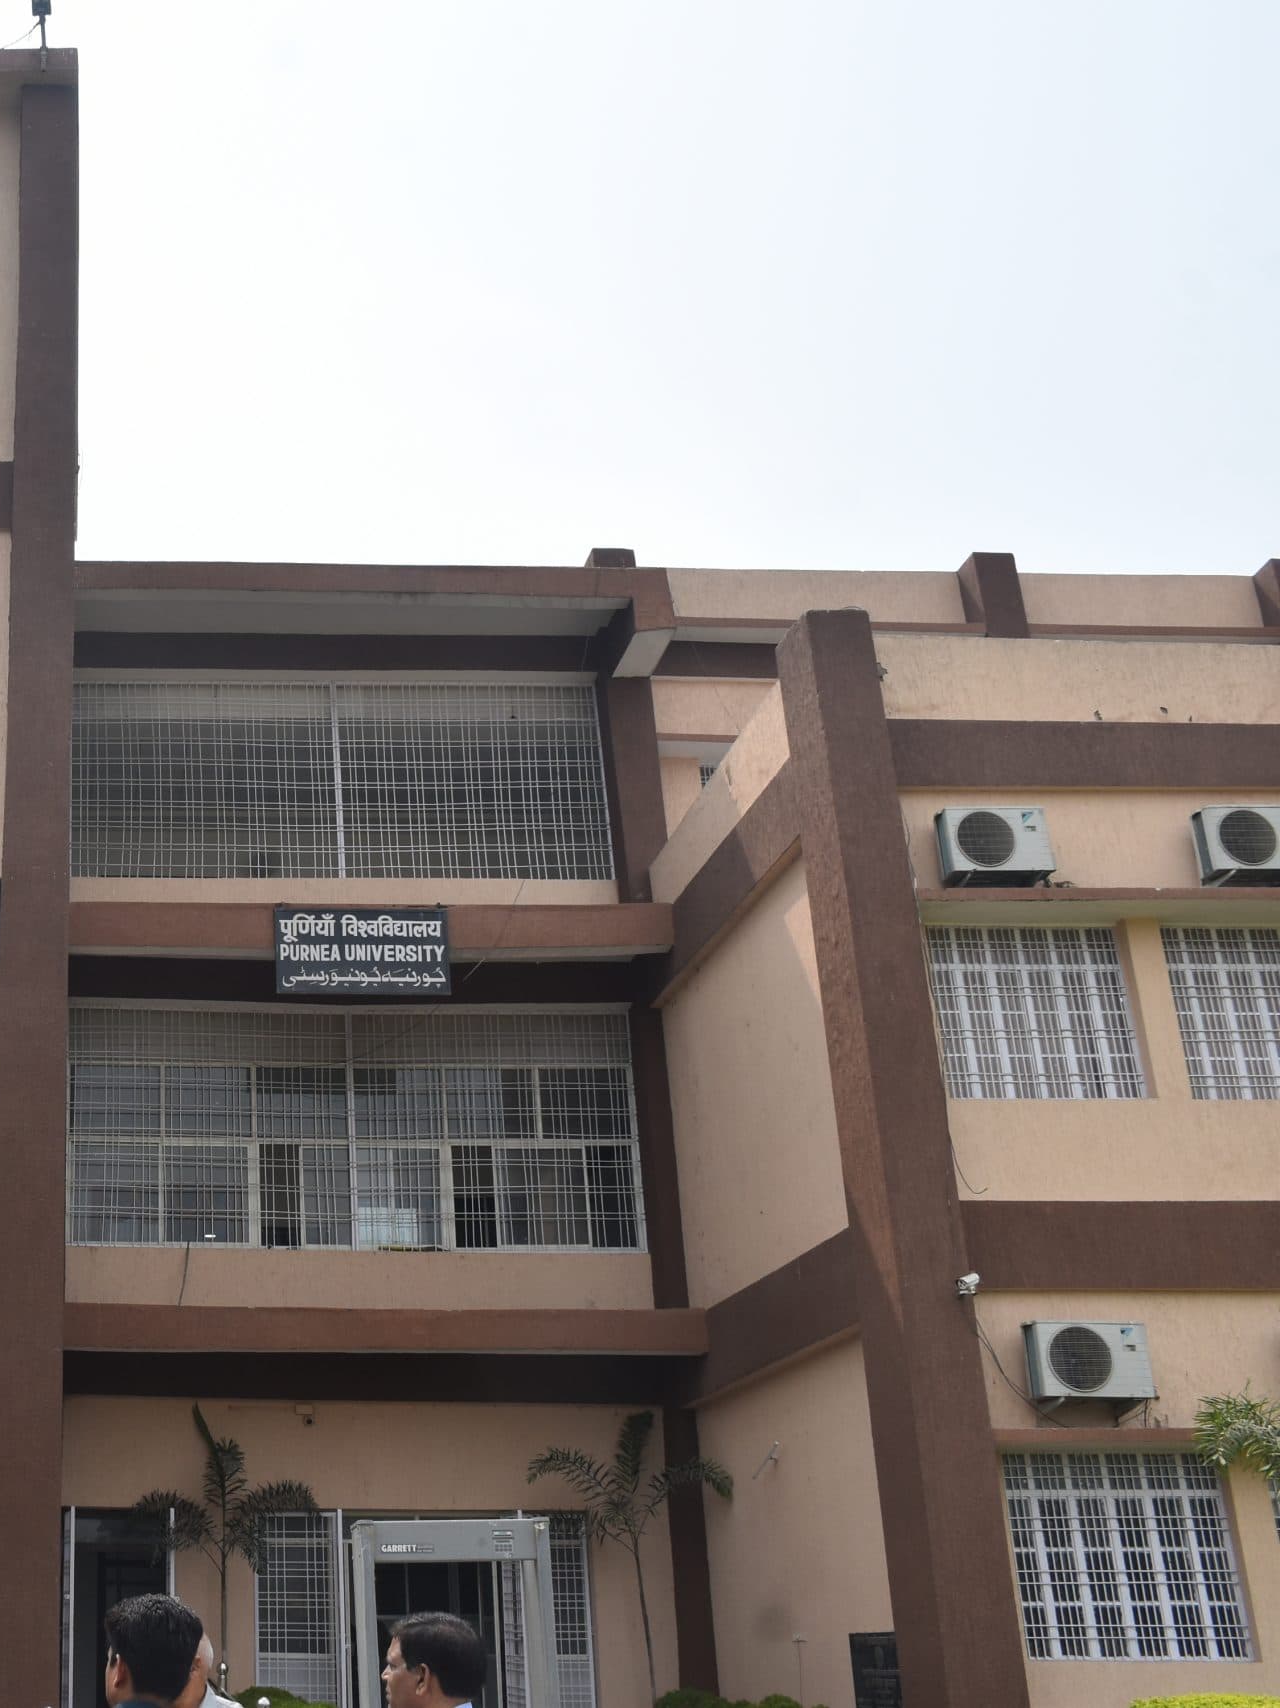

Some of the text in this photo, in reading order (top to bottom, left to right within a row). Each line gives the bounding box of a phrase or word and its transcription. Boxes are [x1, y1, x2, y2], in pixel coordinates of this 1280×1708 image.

[279, 913, 442, 943] पूर्णियाँ विश्वविद्यालय
[279, 944, 445, 962] PURNEA UNIVERSITY
[381, 1544, 417, 1553] GARRETT
